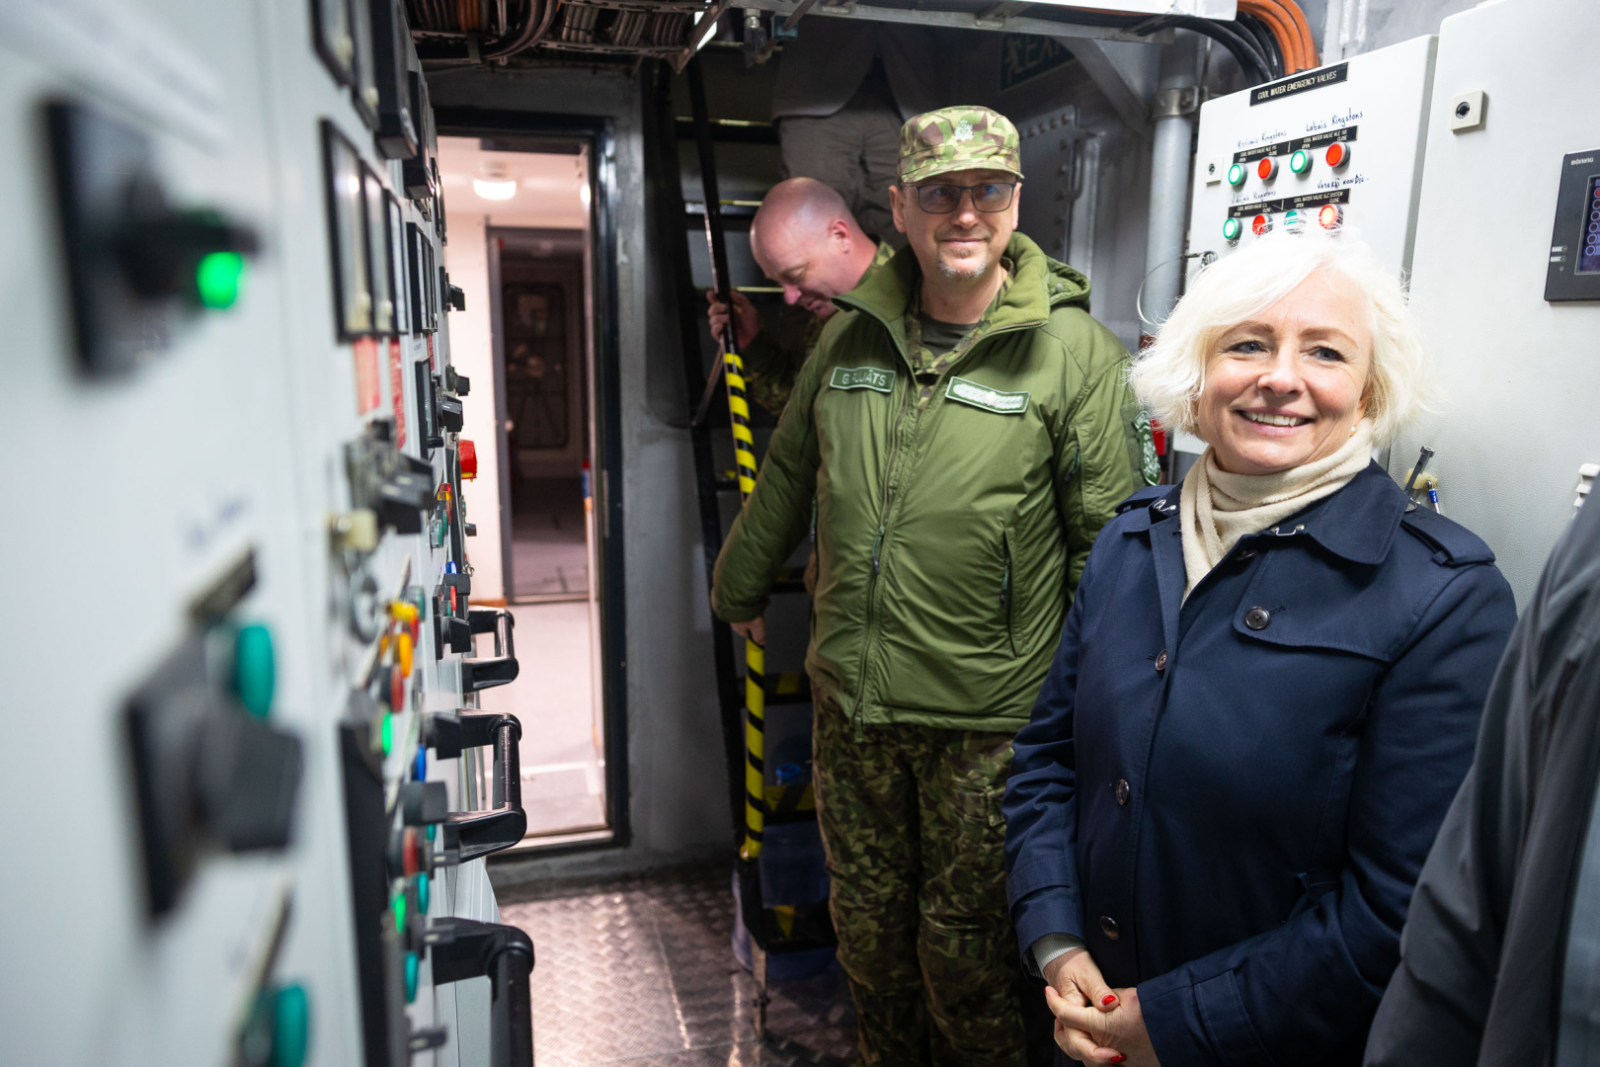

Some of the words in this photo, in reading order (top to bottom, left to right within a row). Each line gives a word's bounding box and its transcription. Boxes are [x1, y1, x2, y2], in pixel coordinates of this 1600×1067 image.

[1258, 91, 1270, 100] COOL
[1270, 85, 1287, 97] WATER
[1287, 76, 1317, 92] EMERGENCY
[1317, 70, 1338, 84] VALVES
